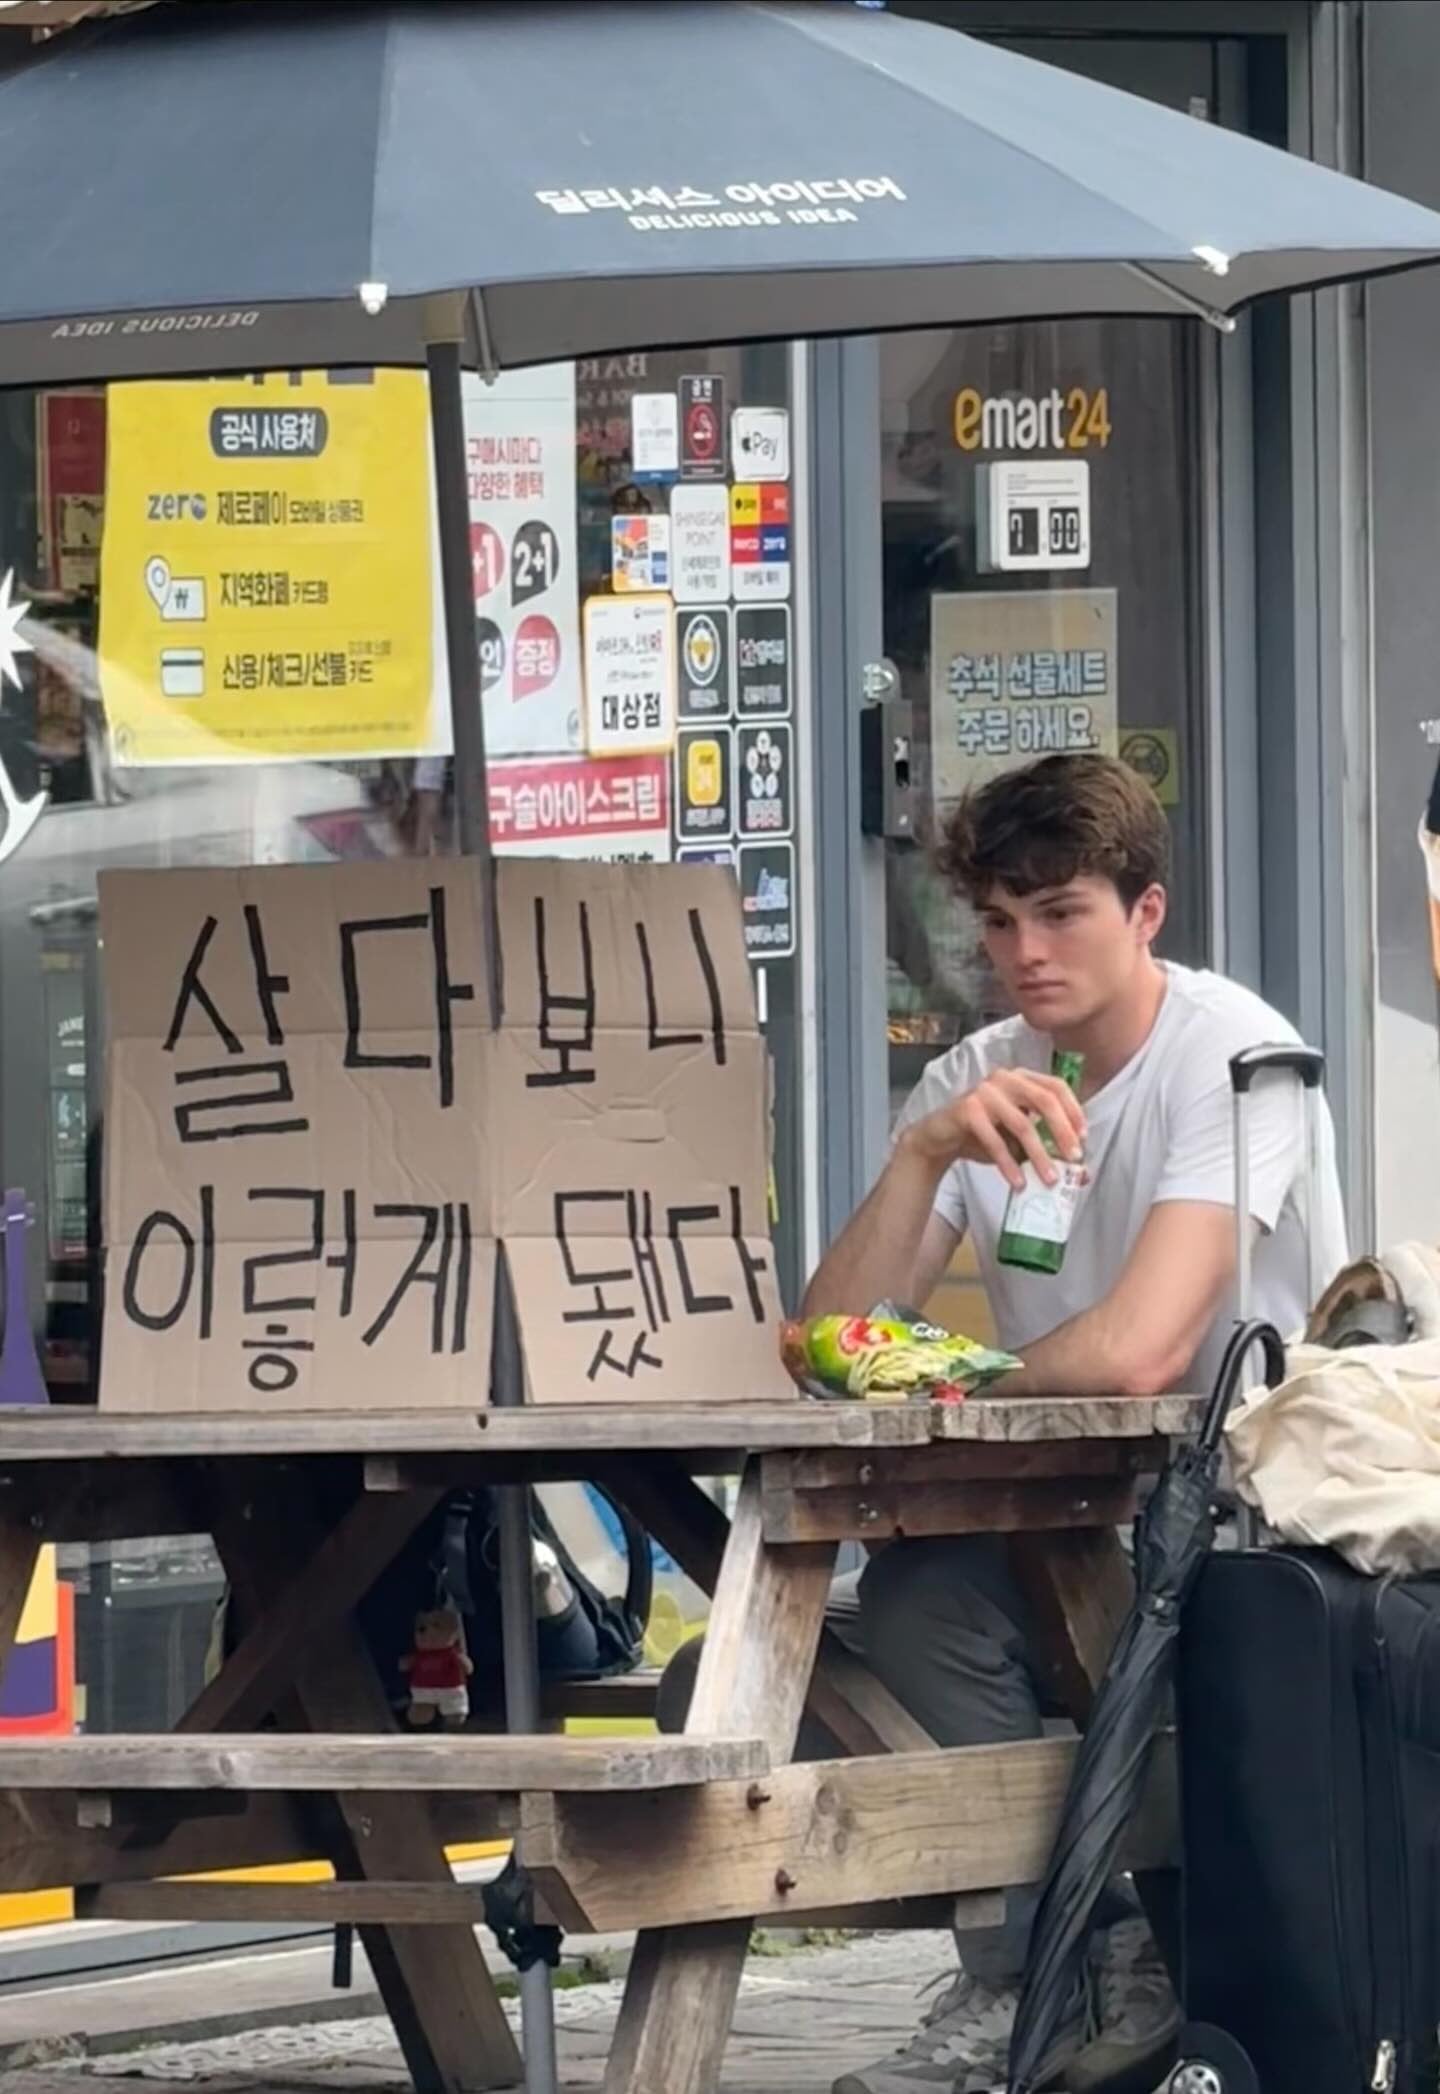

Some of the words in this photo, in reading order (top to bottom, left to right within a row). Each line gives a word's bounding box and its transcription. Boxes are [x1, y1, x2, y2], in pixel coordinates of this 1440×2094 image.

[725, 176, 907, 206] 아이디어
[628, 209, 782, 231] DELICIOUS
[788, 207, 858, 225] IDEA
[221, 413, 258, 451] 공식
[261, 412, 317, 450] 사용처
[954, 387, 1112, 451] emart24
[217, 490, 287, 525] 제로페이
[472, 533, 497, 590] +1
[514, 531, 553, 588] 2+1
[480, 639, 501, 676] 인
[517, 638, 556, 677] 증정
[949, 653, 1000, 700] 추석
[1006, 650, 1108, 698] 선물세트
[958, 707, 1010, 755] 주문
[489, 774, 660, 833] 구슬아이스크림
[122, 1185, 470, 1392] 이렇게
[553, 1186, 767, 1381] 됐다
